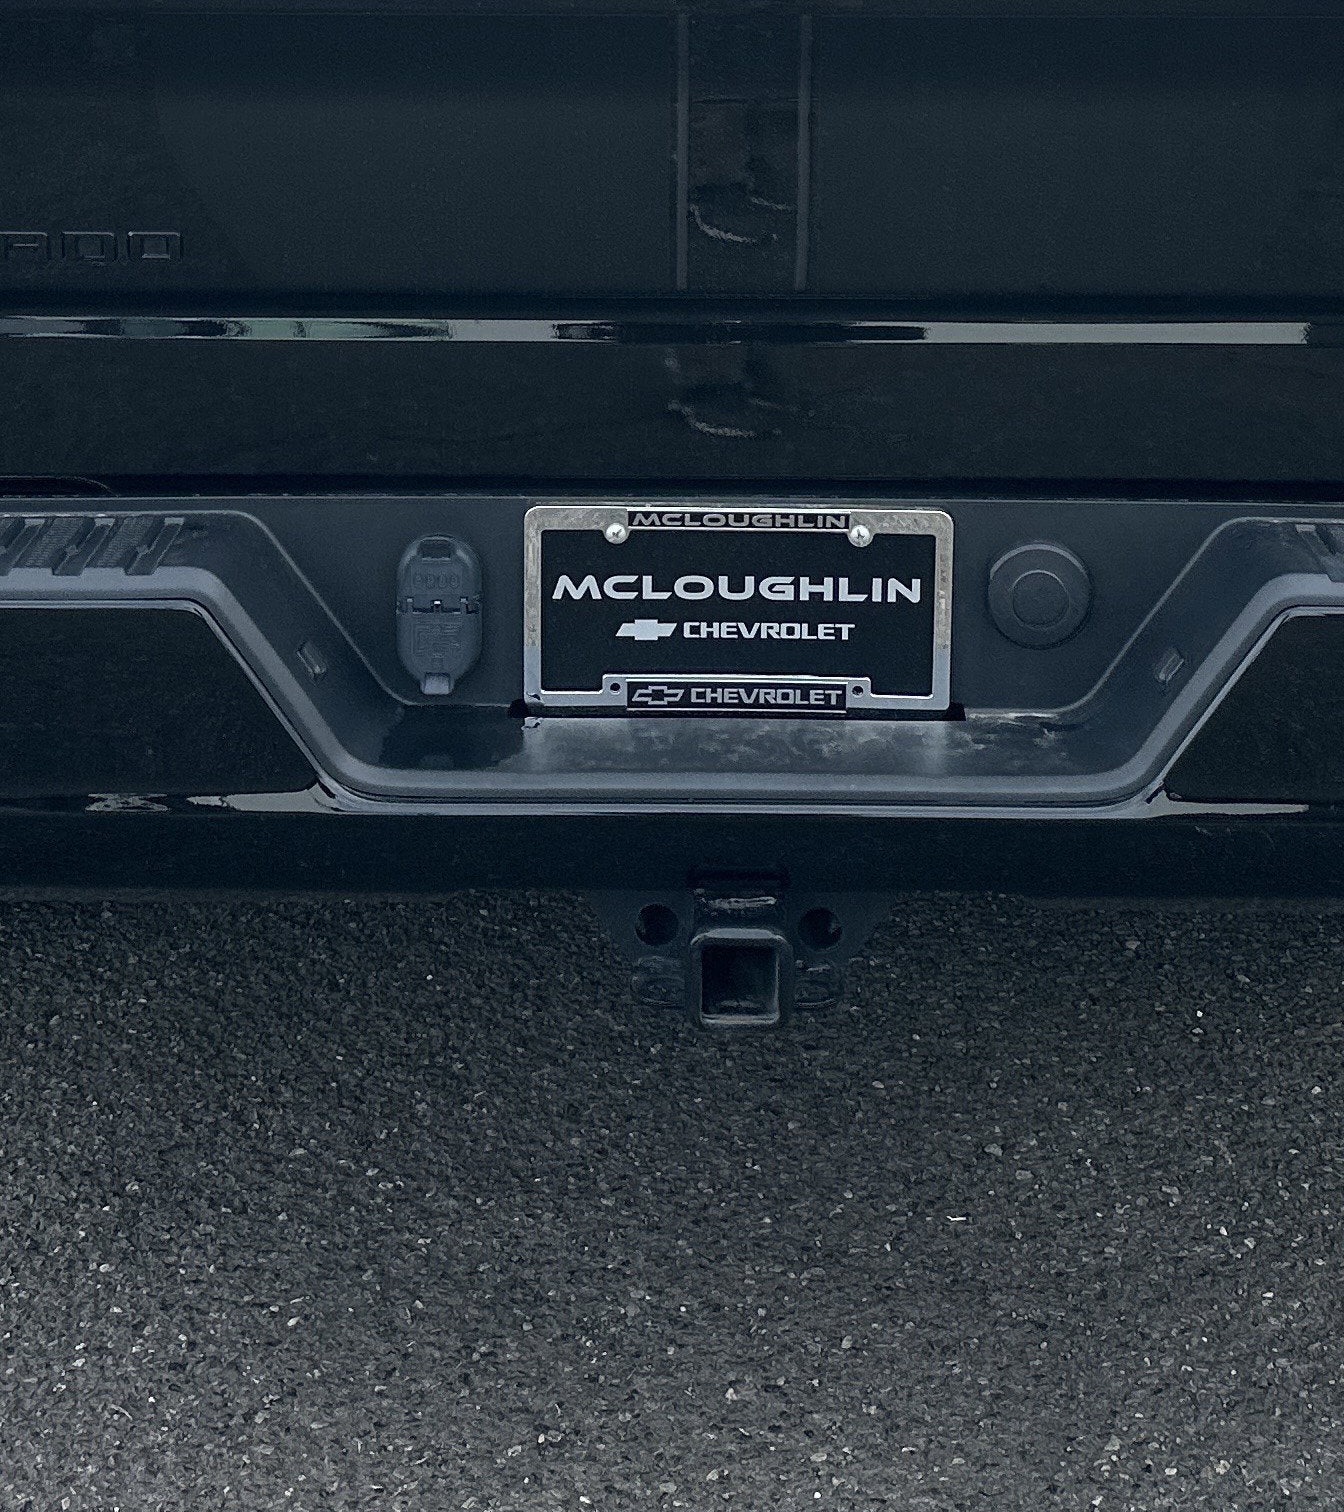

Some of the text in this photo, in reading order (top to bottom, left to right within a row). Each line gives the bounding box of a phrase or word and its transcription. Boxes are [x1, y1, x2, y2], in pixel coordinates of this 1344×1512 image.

[632, 512, 848, 529] MCLOUGHLIN
[552, 574, 921, 604] MCLOUGHLIN
[683, 621, 856, 641] CHEVROLET
[690, 687, 843, 706] CHEVROLET
